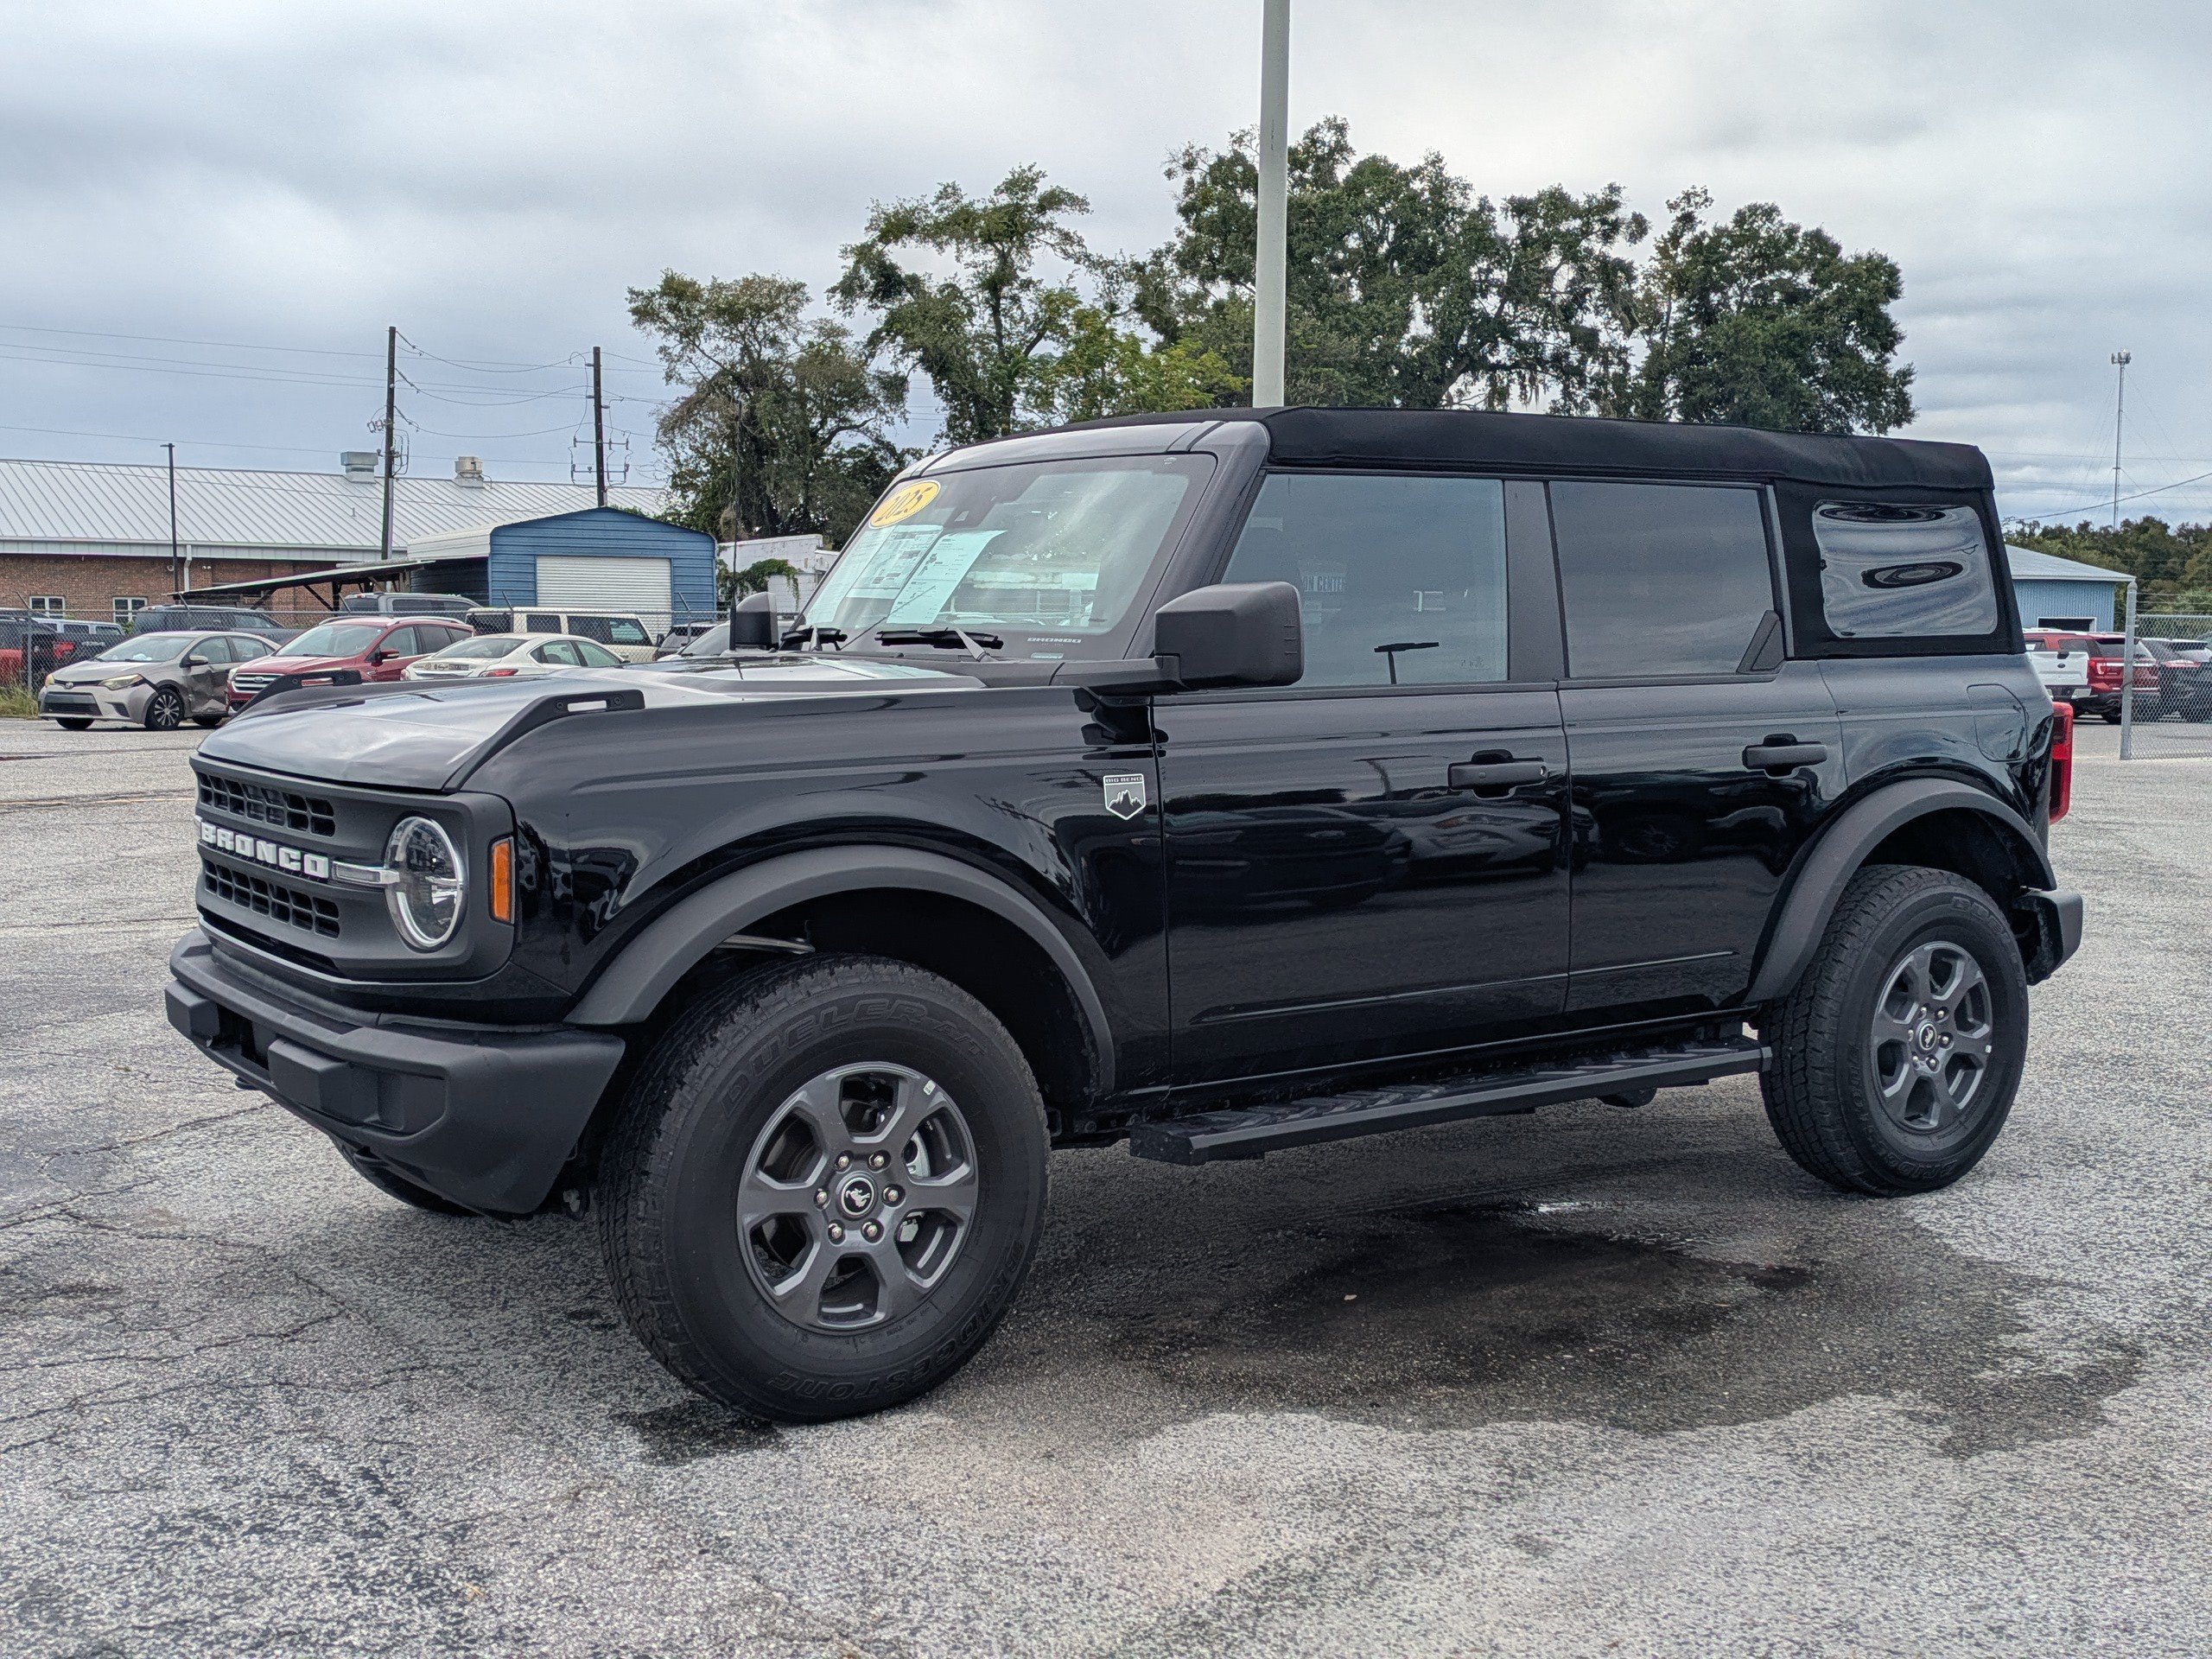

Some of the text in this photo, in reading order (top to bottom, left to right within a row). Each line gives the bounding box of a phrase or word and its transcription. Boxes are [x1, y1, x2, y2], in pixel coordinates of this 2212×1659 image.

[200, 821, 329, 880] BRONCO
[720, 997, 928, 1121] DUELER
[766, 1237, 1027, 1402] BRIDGESTONE
